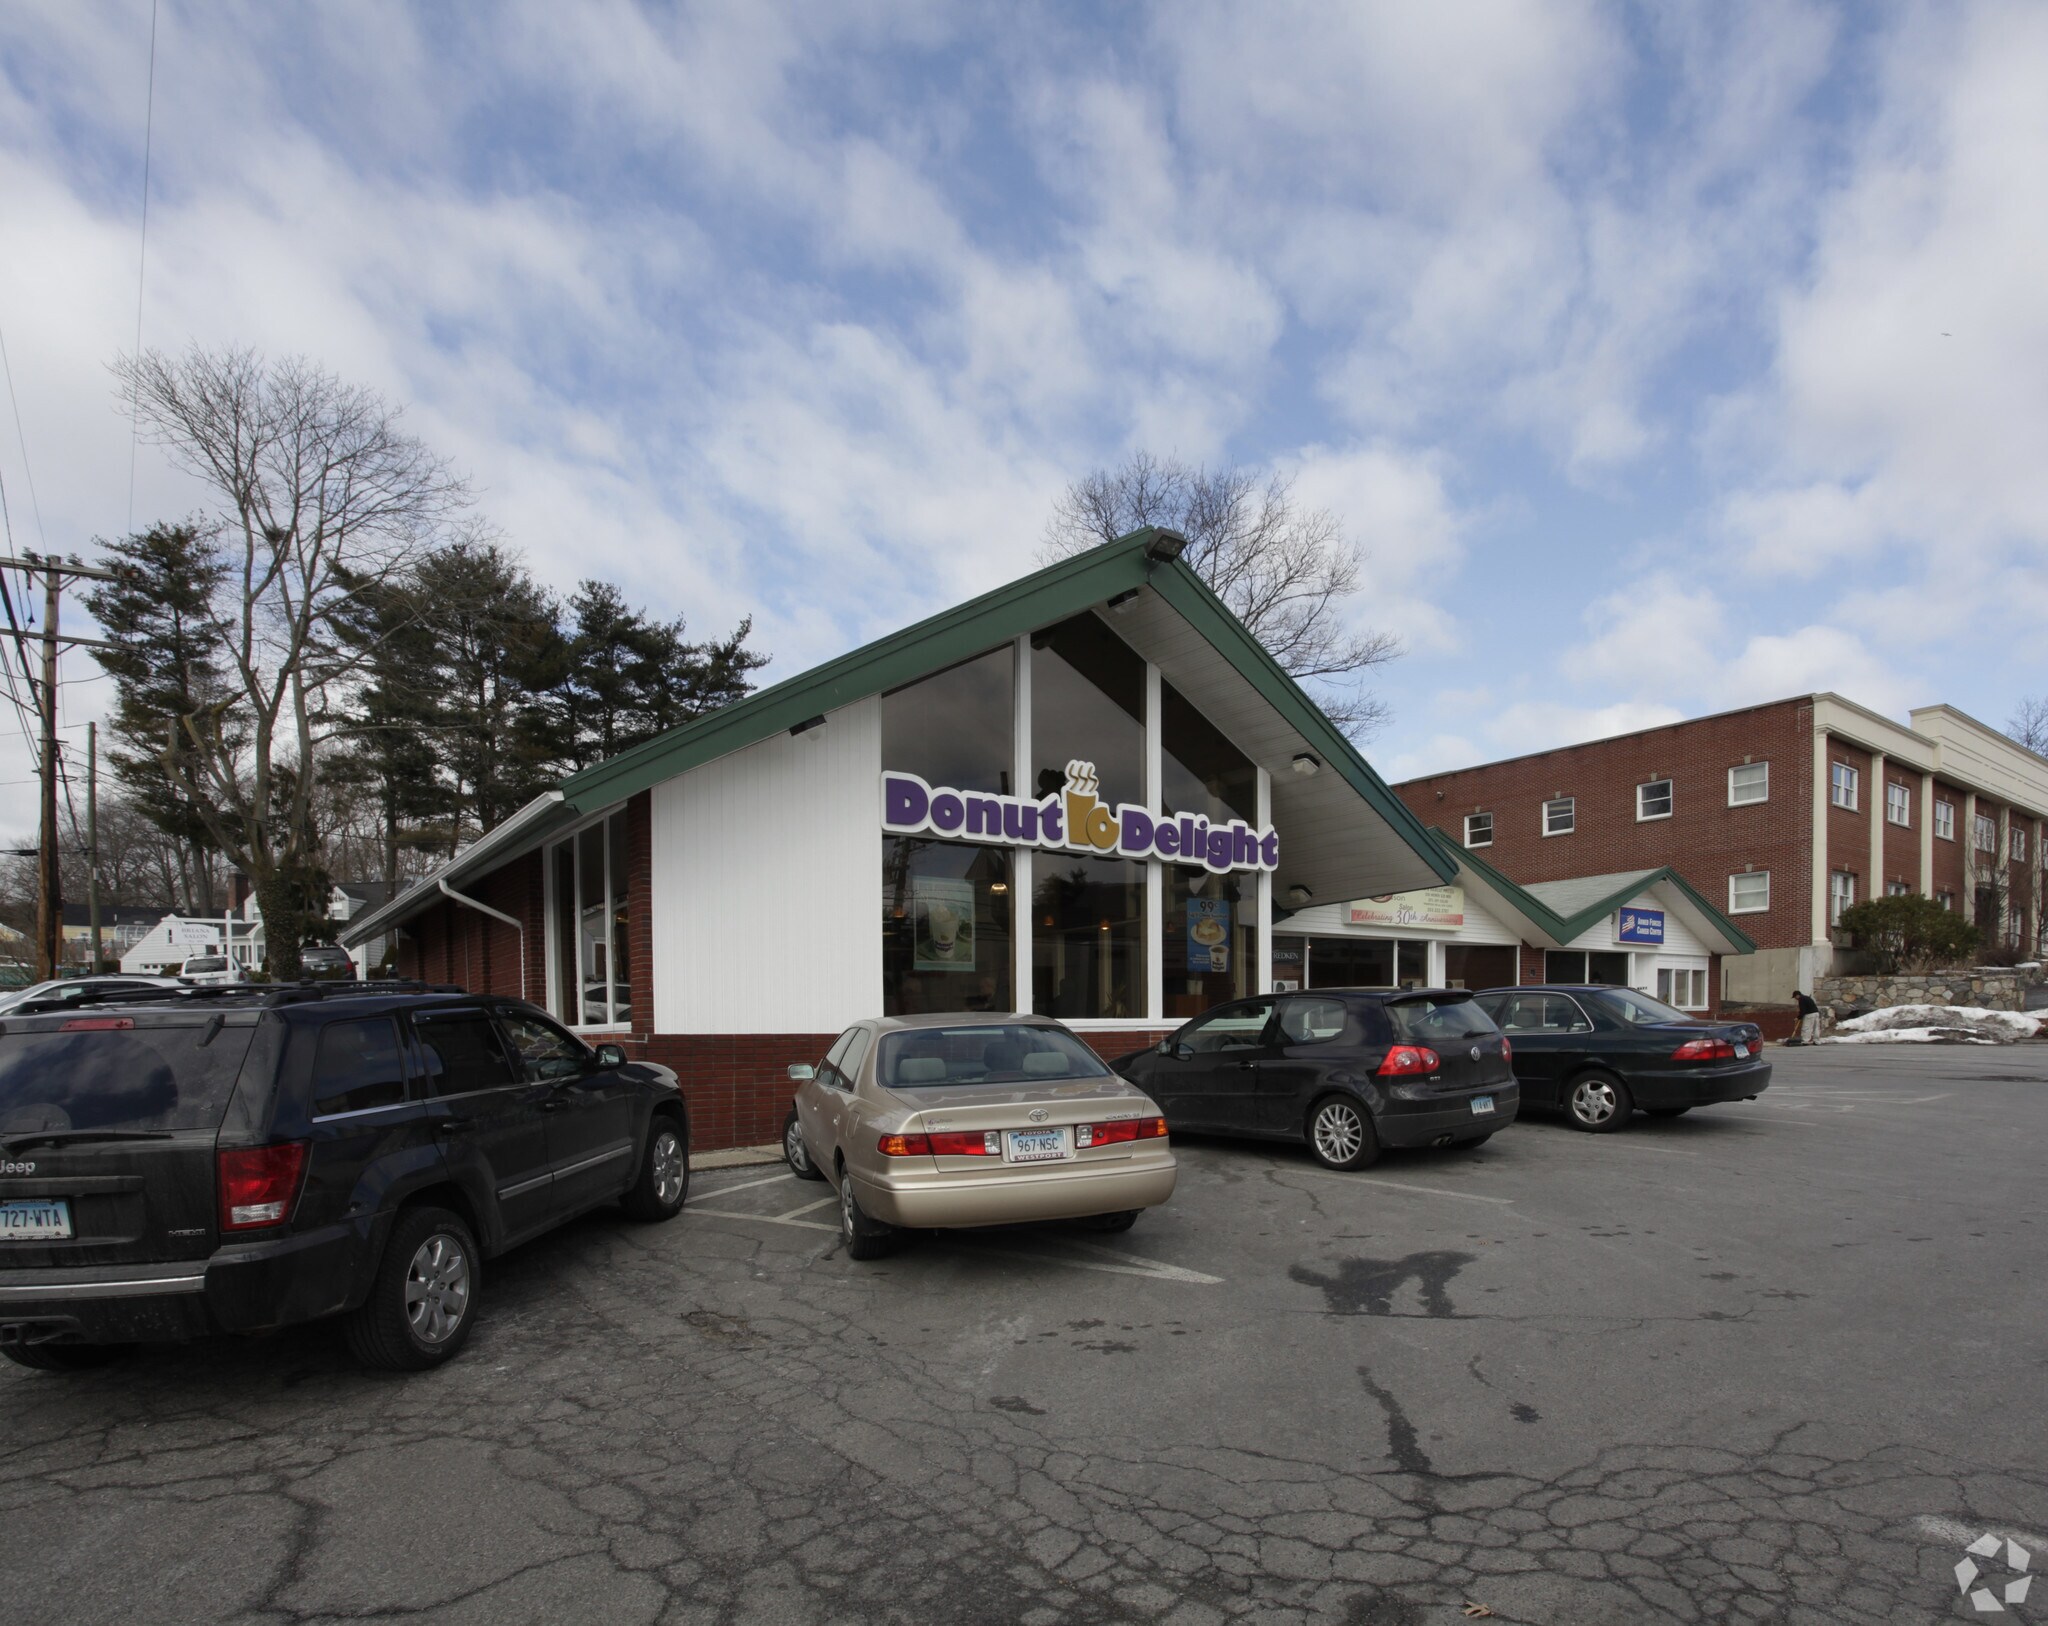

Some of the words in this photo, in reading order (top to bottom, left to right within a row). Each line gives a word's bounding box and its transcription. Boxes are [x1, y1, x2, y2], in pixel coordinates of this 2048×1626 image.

[885, 776, 1063, 842] Donut
[1121, 809, 1279, 869] Delight
[1273, 951, 1299, 960] REDKEN
[1017, 1152, 1061, 1160] WESTPORT
[0, 1160, 36, 1175] Jeep
